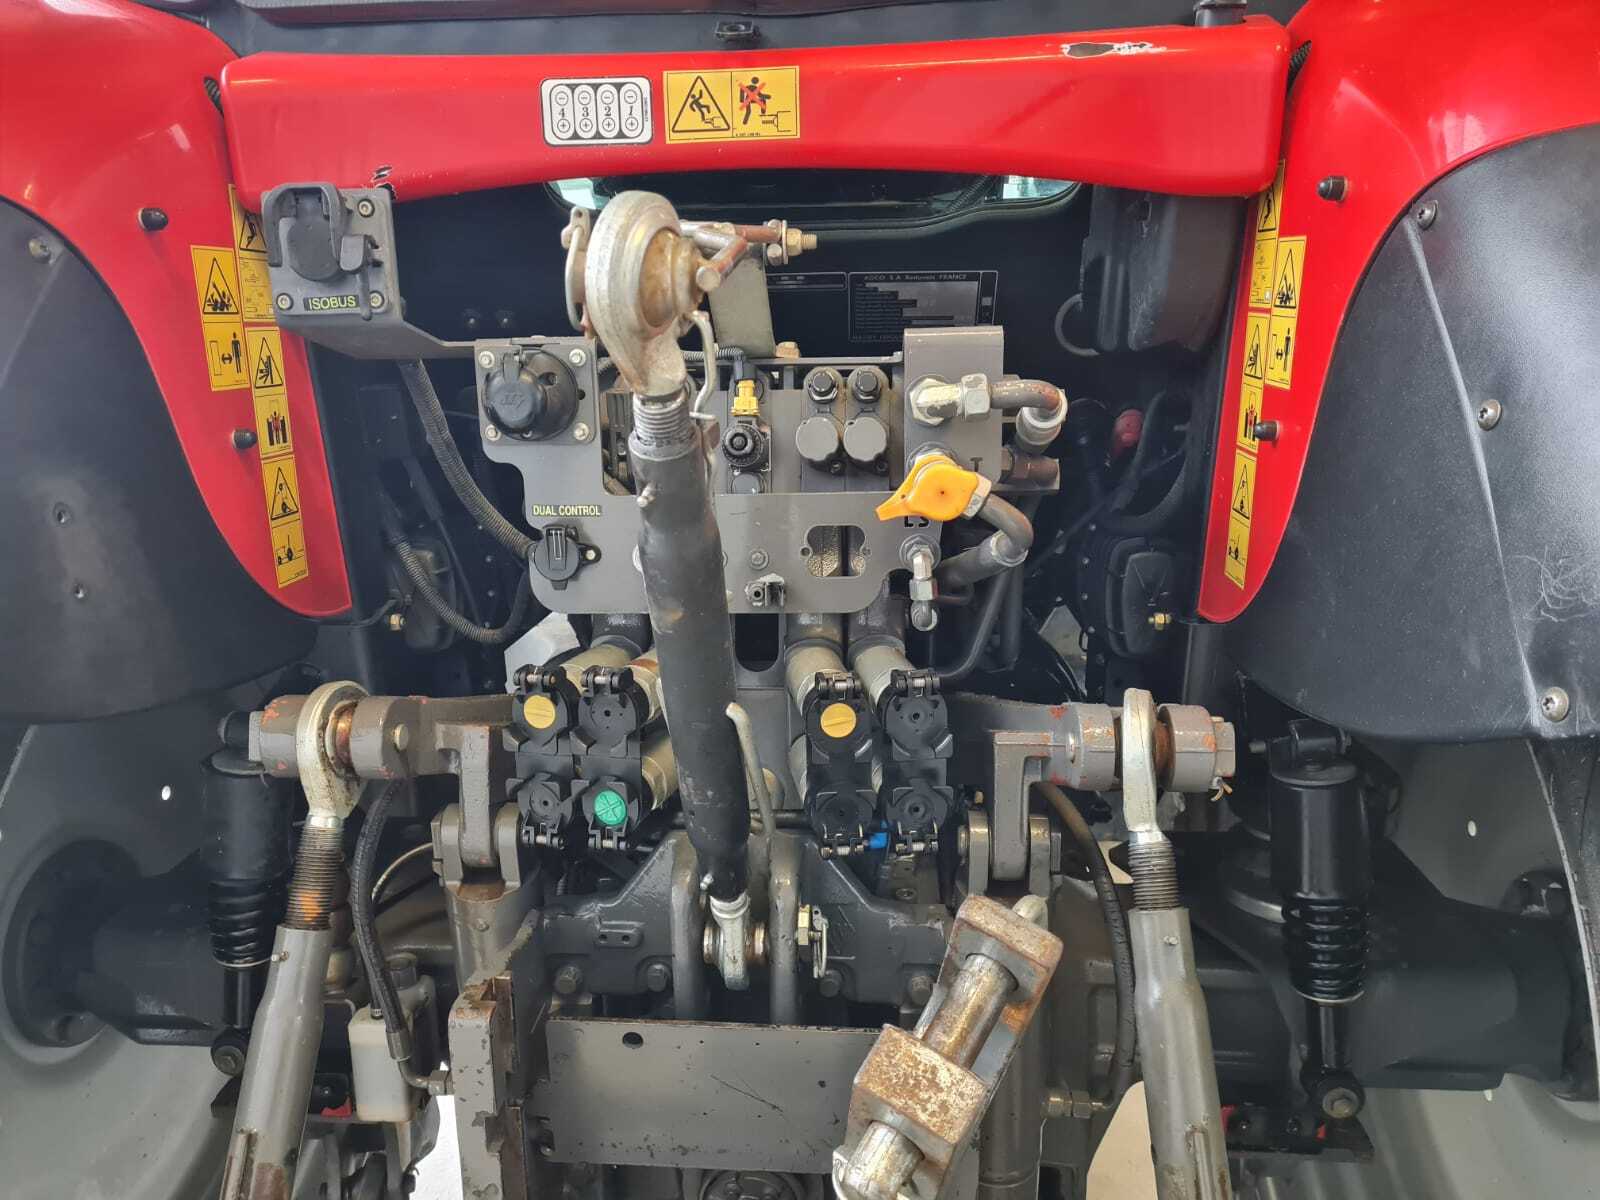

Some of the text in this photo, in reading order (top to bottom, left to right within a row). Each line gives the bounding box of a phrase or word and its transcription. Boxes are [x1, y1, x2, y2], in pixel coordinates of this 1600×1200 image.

[558, 108, 566, 118] 4
[582, 106, 590, 117] 3
[604, 105, 612, 117] 2
[628, 105, 634, 116] 1
[308, 295, 357, 311] ISOBUS
[533, 504, 601, 516] DUAL CONTROL
